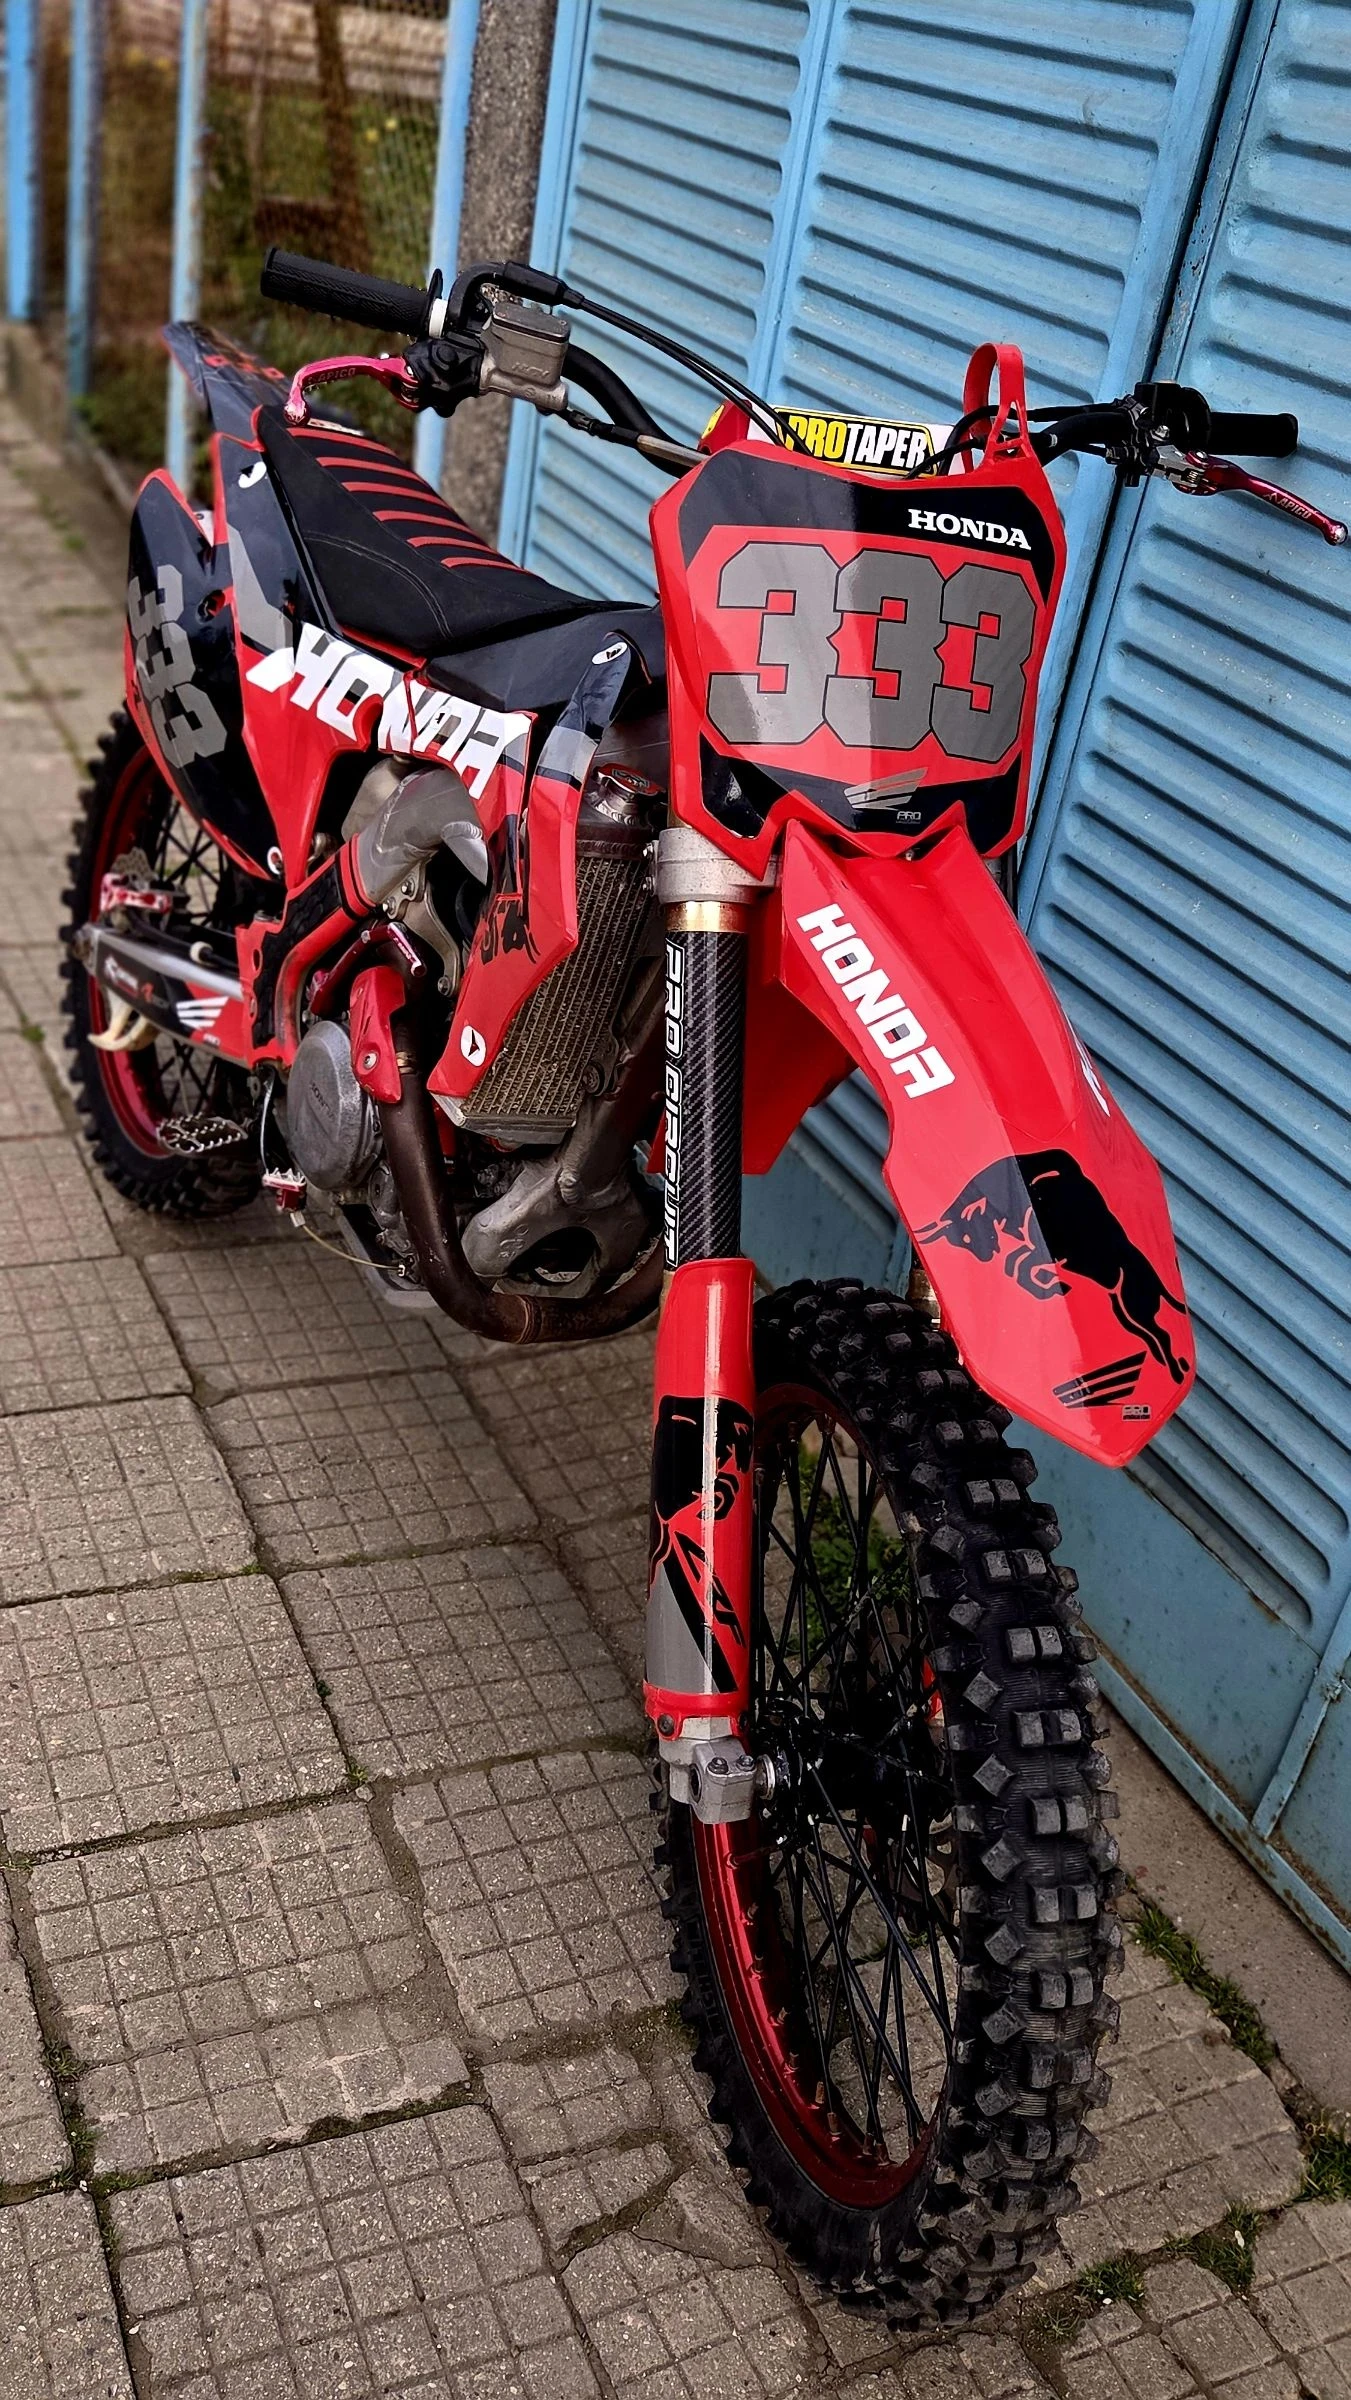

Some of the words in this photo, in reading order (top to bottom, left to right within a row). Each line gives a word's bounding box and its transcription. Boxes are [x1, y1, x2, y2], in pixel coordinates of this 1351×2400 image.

[785, 414, 928, 469] PROTAPER
[908, 508, 1032, 550] HONDA
[128, 564, 228, 769] 333
[246, 622, 532, 800] HONDA
[707, 541, 1036, 764] 333
[897, 811, 921, 820] PRO
[666, 939, 685, 1058] PRO
[796, 903, 956, 1099] HONDA
